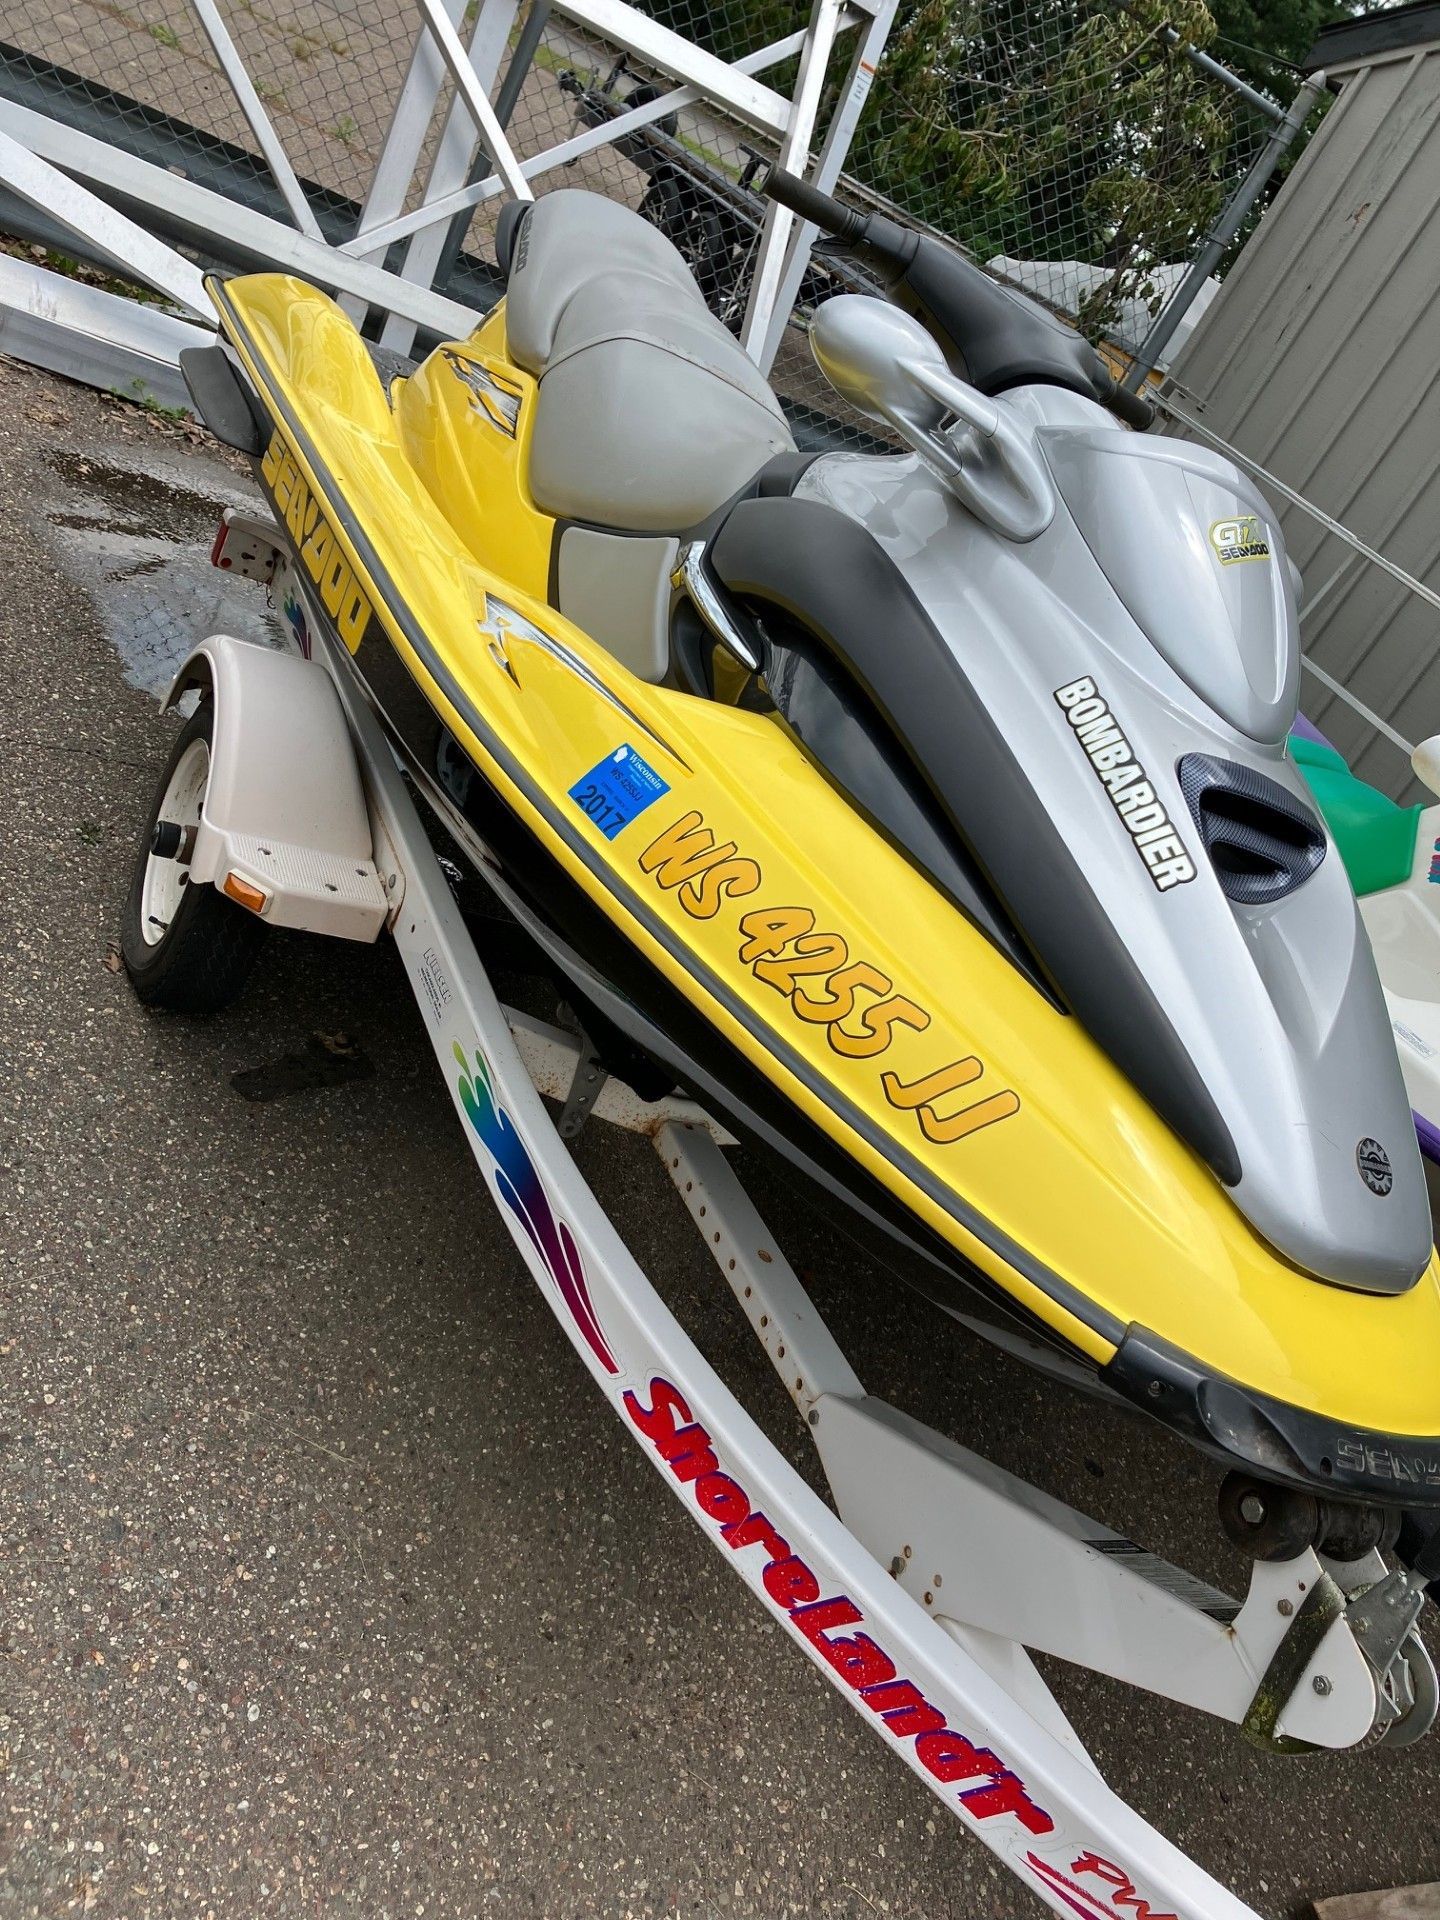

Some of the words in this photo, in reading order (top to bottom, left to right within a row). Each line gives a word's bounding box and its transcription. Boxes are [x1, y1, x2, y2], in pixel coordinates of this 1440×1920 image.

[575, 784, 626, 833] 2017
[629, 753, 662, 790] Wisconsin
[1054, 676, 1196, 892] BOMBARDIER
[638, 810, 761, 920] WS
[739, 906, 931, 1059] 4255
[880, 1055, 1020, 1145] JJ
